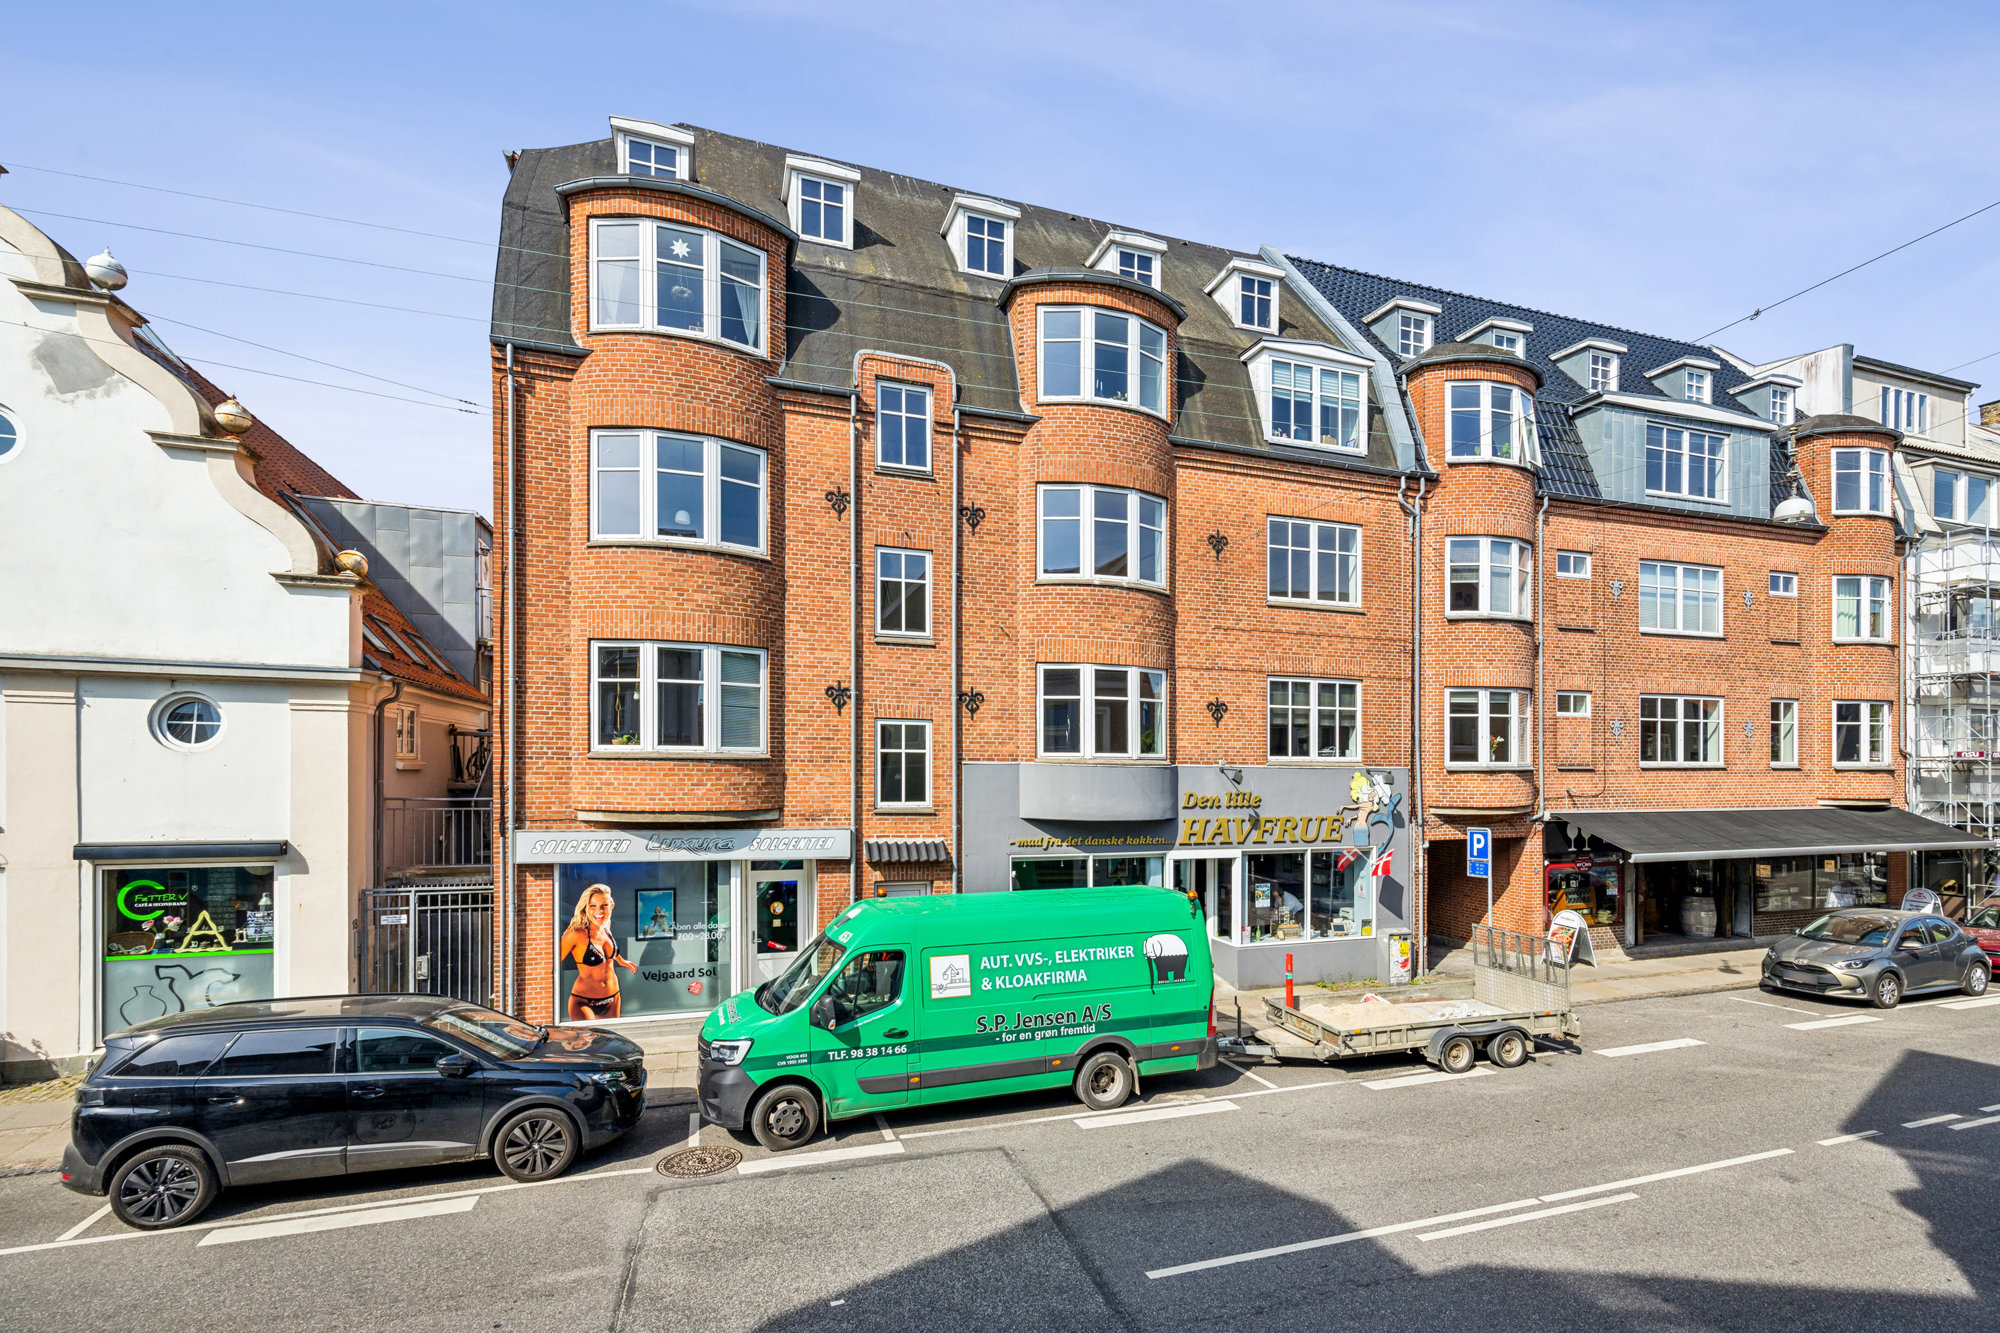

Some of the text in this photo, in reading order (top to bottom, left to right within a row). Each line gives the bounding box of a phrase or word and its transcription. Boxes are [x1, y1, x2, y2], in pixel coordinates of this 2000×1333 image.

[1182, 789, 1261, 809] Den lille
[1178, 815, 1344, 846] HAVFRUE
[531, 838, 631, 855] SOLCENTER
[748, 836, 836, 851] SOLCENTER
[1017, 837, 1043, 847] mad
[1043, 837, 1062, 851] fra
[1064, 835, 1082, 846] det
[1084, 835, 1124, 846] danske
[1473, 833, 1485, 856] P
[980, 945, 1135, 970] AUT. VVS-, ELEKTRIKER
[642, 966, 717, 982] Vejgaard Sol
[981, 969, 1087, 990] & KLOAKFIRMA
[976, 1003, 1112, 1033] S.P. Jensen A/S
[1002, 1032, 1017, 1042] for
[1019, 1032, 1032, 1040] en
[1034, 1030, 1058, 1041] grøn
[1060, 1023, 1096, 1036] fremtid
[828, 1044, 907, 1061] TLF. 98 38 14 66
